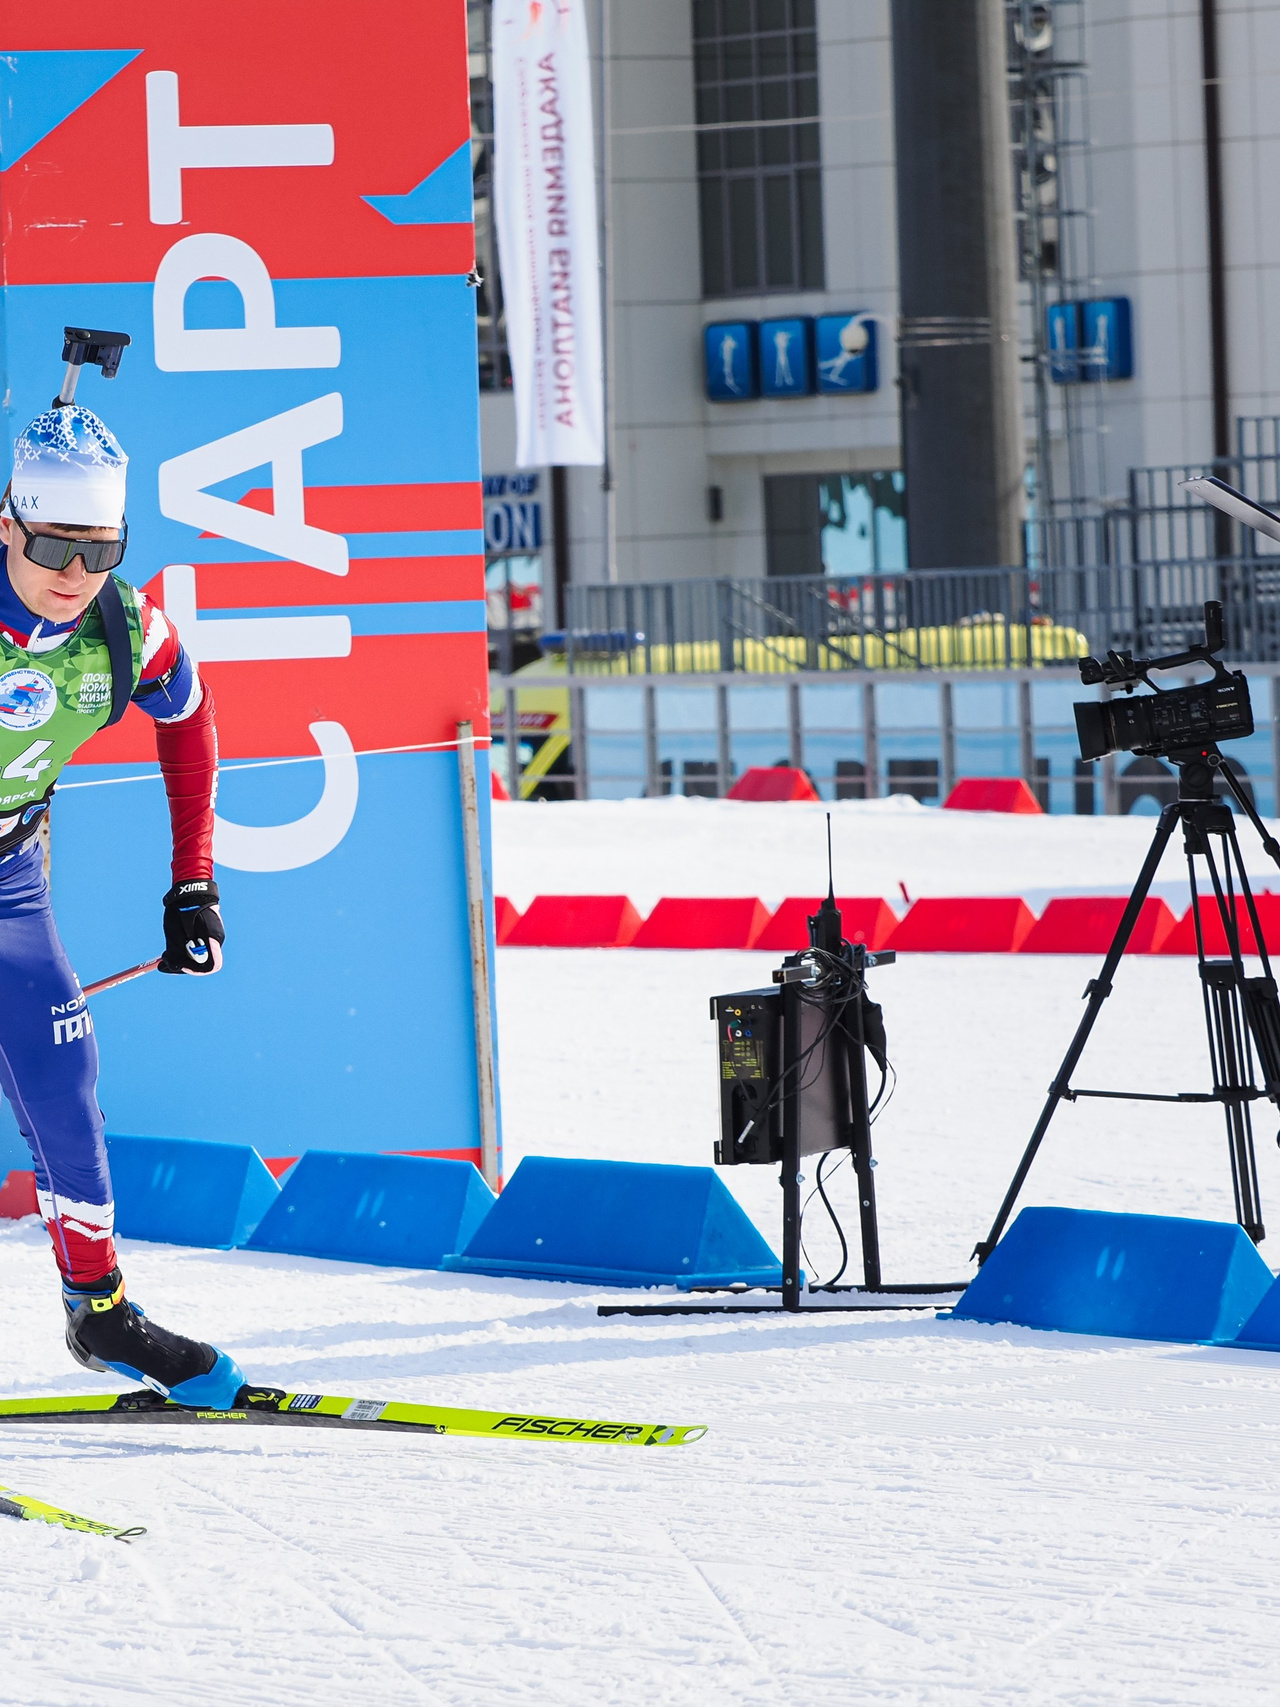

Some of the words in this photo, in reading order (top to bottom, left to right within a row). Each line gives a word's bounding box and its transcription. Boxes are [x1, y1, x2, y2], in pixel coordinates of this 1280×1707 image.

[146, 70, 359, 873] СТАРТ
[485, 502, 536, 552] ON
[80, 682, 112, 692] НОРМ
[179, 882, 208, 895] SWIX
[197, 1412, 247, 1420] FISCHER
[492, 1416, 643, 1440] FISCHER
